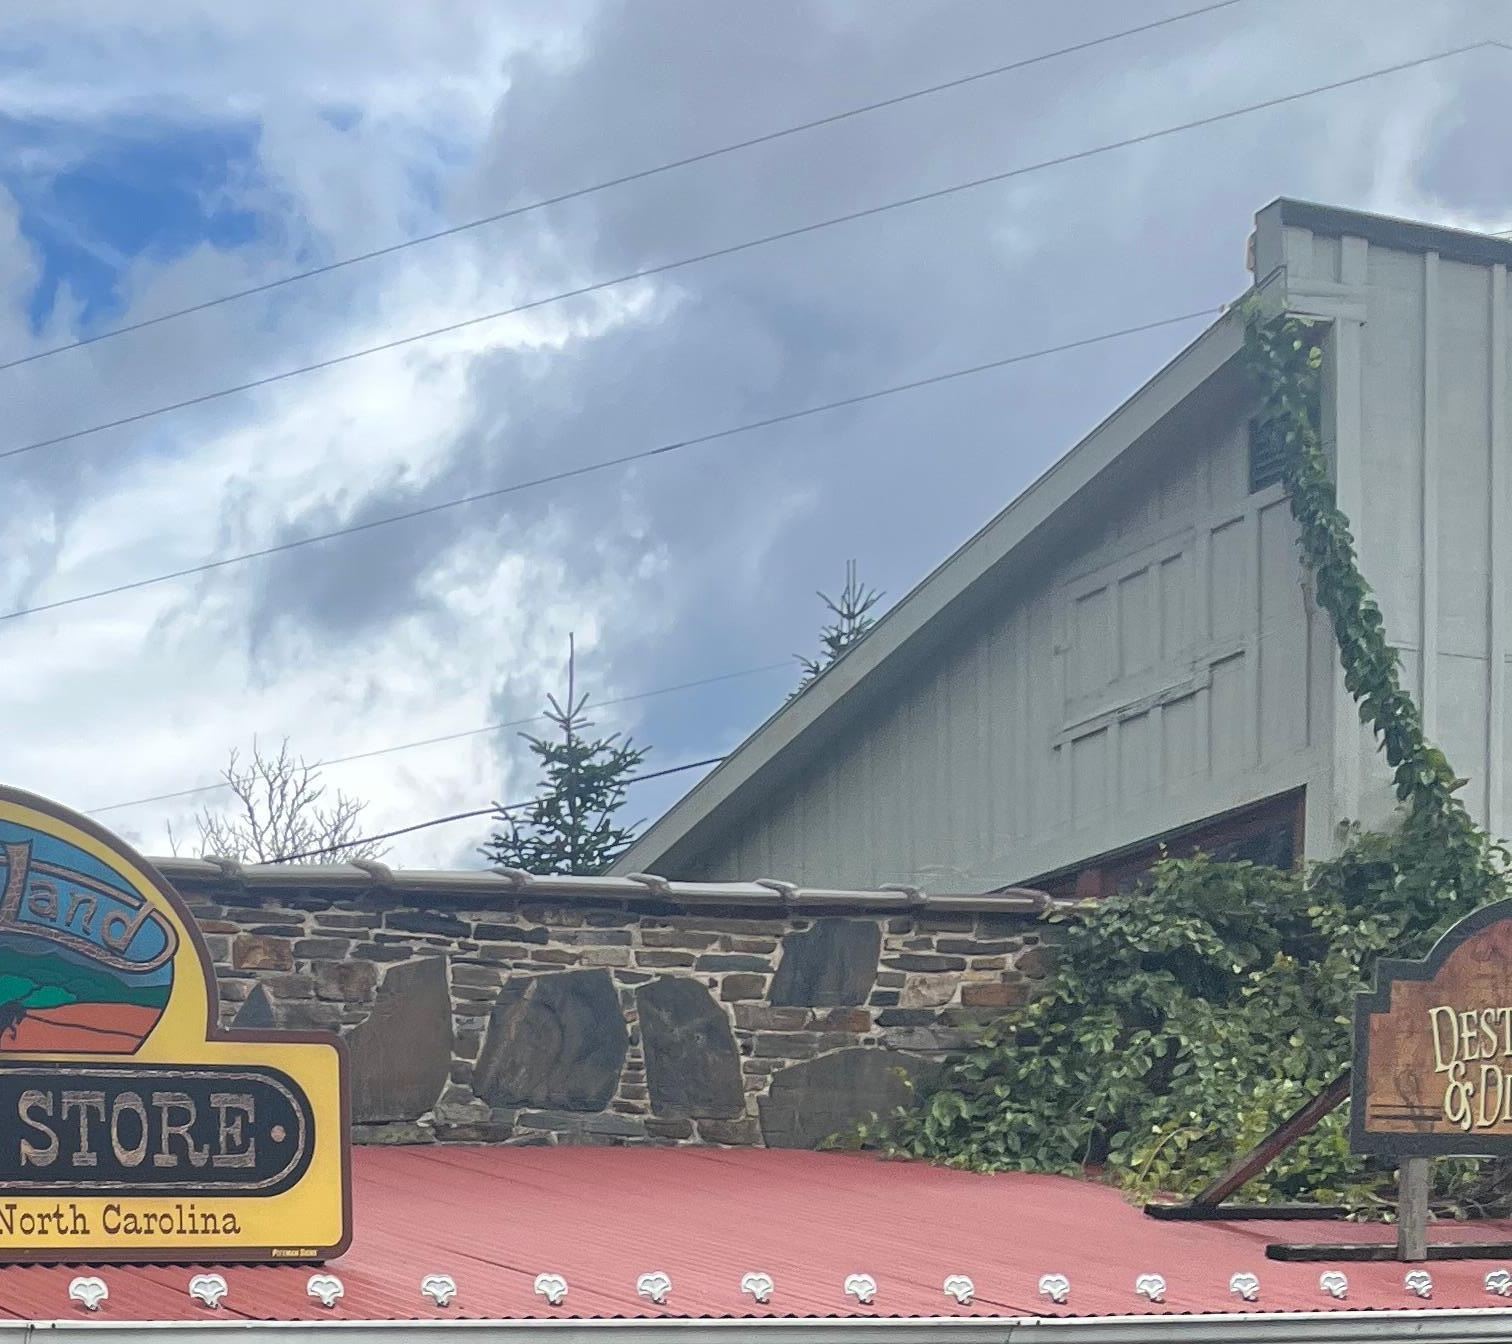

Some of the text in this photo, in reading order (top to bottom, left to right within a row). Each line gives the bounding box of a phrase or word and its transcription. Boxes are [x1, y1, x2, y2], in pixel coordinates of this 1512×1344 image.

[17, 1088, 256, 1169] STORE
[1444, 1060, 1475, 1131] &
[101, 1203, 241, 1236] Carolina
